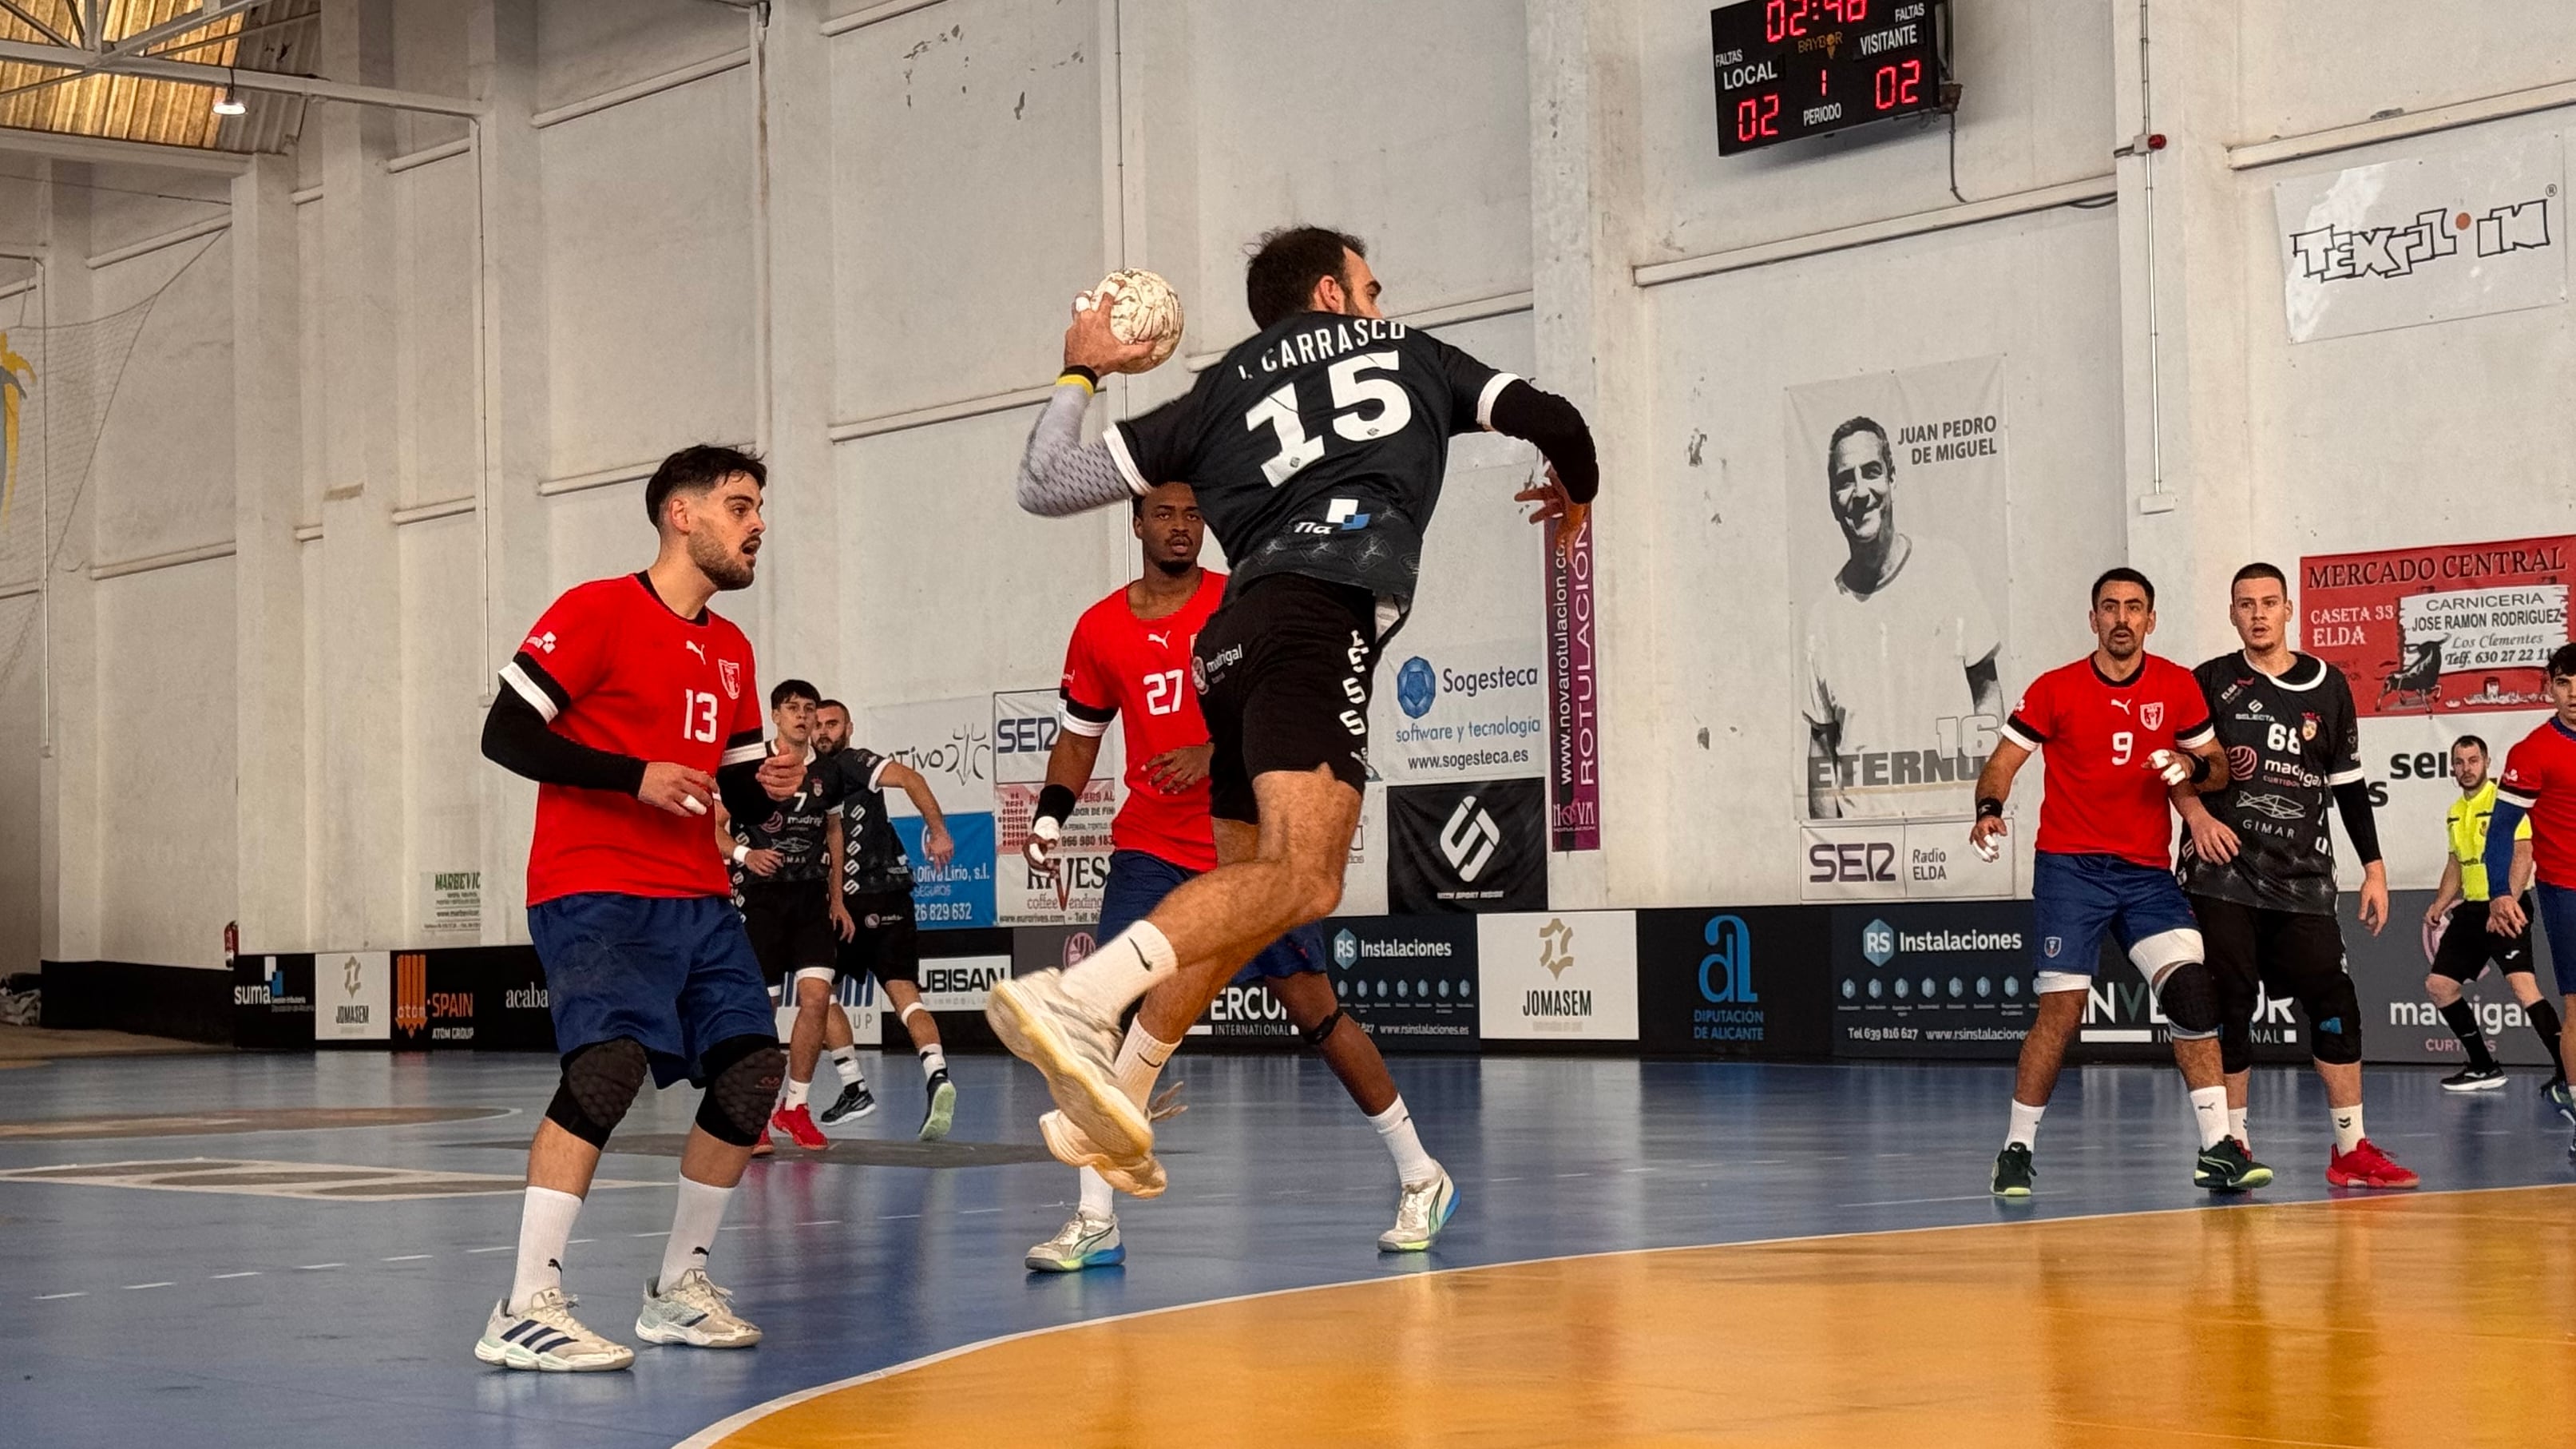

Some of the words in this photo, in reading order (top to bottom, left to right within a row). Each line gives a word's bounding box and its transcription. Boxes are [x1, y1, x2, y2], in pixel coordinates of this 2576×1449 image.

[1895, 2, 1925, 22] FALTAS
[1860, 24, 1918, 56] VISITANTE
[1715, 49, 1743, 67] FALTAS
[1723, 62, 1777, 90] LOCAL
[1821, 69, 1828, 97] 1
[1875, 60, 1920, 110] 02
[1738, 93, 1780, 142] 02
[1803, 103, 1842, 126] PERIODO
[1261, 320, 1406, 372] CARRASCO
[1246, 350, 1412, 488] 15
[1897, 423, 1938, 446] JUAN
[1943, 415, 1997, 439] PEDRO
[1912, 447, 1932, 465] DE
[1936, 438, 1997, 462] MIGUEL
[2307, 557, 2436, 590] MERCADO
[2442, 546, 2566, 578] CENTRAL
[2426, 592, 2544, 612] CARNICERIA
[2310, 607, 2371, 625] CASETA
[2375, 605, 2394, 619] 33
[2412, 616, 2441, 632] JOSE
[2445, 613, 2487, 630] RAMON
[2491, 608, 2562, 627] RODRIGUEZ
[2312, 626, 2366, 647] ELDA
[2451, 636, 2475, 649] Los
[2479, 633, 2543, 649] Clementes
[2475, 651, 2498, 664] 630
[2500, 650, 2515, 662] 27
[2518, 649, 2533, 661] 22
[1143, 669, 1183, 716] 27
[1442, 667, 1538, 697] Sogesteca
[684, 689, 718, 743] 13
[1396, 721, 1452, 744] software
[1457, 725, 1464, 742] y
[1468, 716, 1540, 738] tecnología
[1936, 713, 2000, 760] 16
[1408, 748, 1528, 770] www.sogesteca.es
[2111, 732, 2134, 766] 9
[794, 792, 807, 812] 7
[2242, 819, 2296, 840] GIMAR
[1809, 843, 1896, 882] SER
[1912, 848, 1947, 863] Radio
[1913, 867, 1947, 880] ELDA
[929, 903, 949, 920] 829
[952, 902, 973, 919] 632
[1027, 894, 1058, 909] coffee
[1336, 939, 1355, 959] RS
[1361, 938, 1452, 959] Instalaciones
[1866, 931, 1891, 953] RS
[1900, 928, 2023, 952] Instalaciones
[234, 984, 271, 1005] suma
[432, 992, 474, 1018] SPAIN
[1523, 990, 1591, 1017] JOMASEM
[336, 1006, 369, 1024] JOMASEM
[1693, 1007, 1764, 1024] DIPUTACIÓN
[1215, 1024, 1289, 1035] INTERNATIONAL
[1380, 1023, 1469, 1036] www.rsinstalaciones.es
[1693, 1026, 1709, 1040] DE
[1710, 1026, 1764, 1041] ALICANTE
[1848, 1027, 1863, 1039] Tel
[1864, 1027, 1881, 1041] 639
